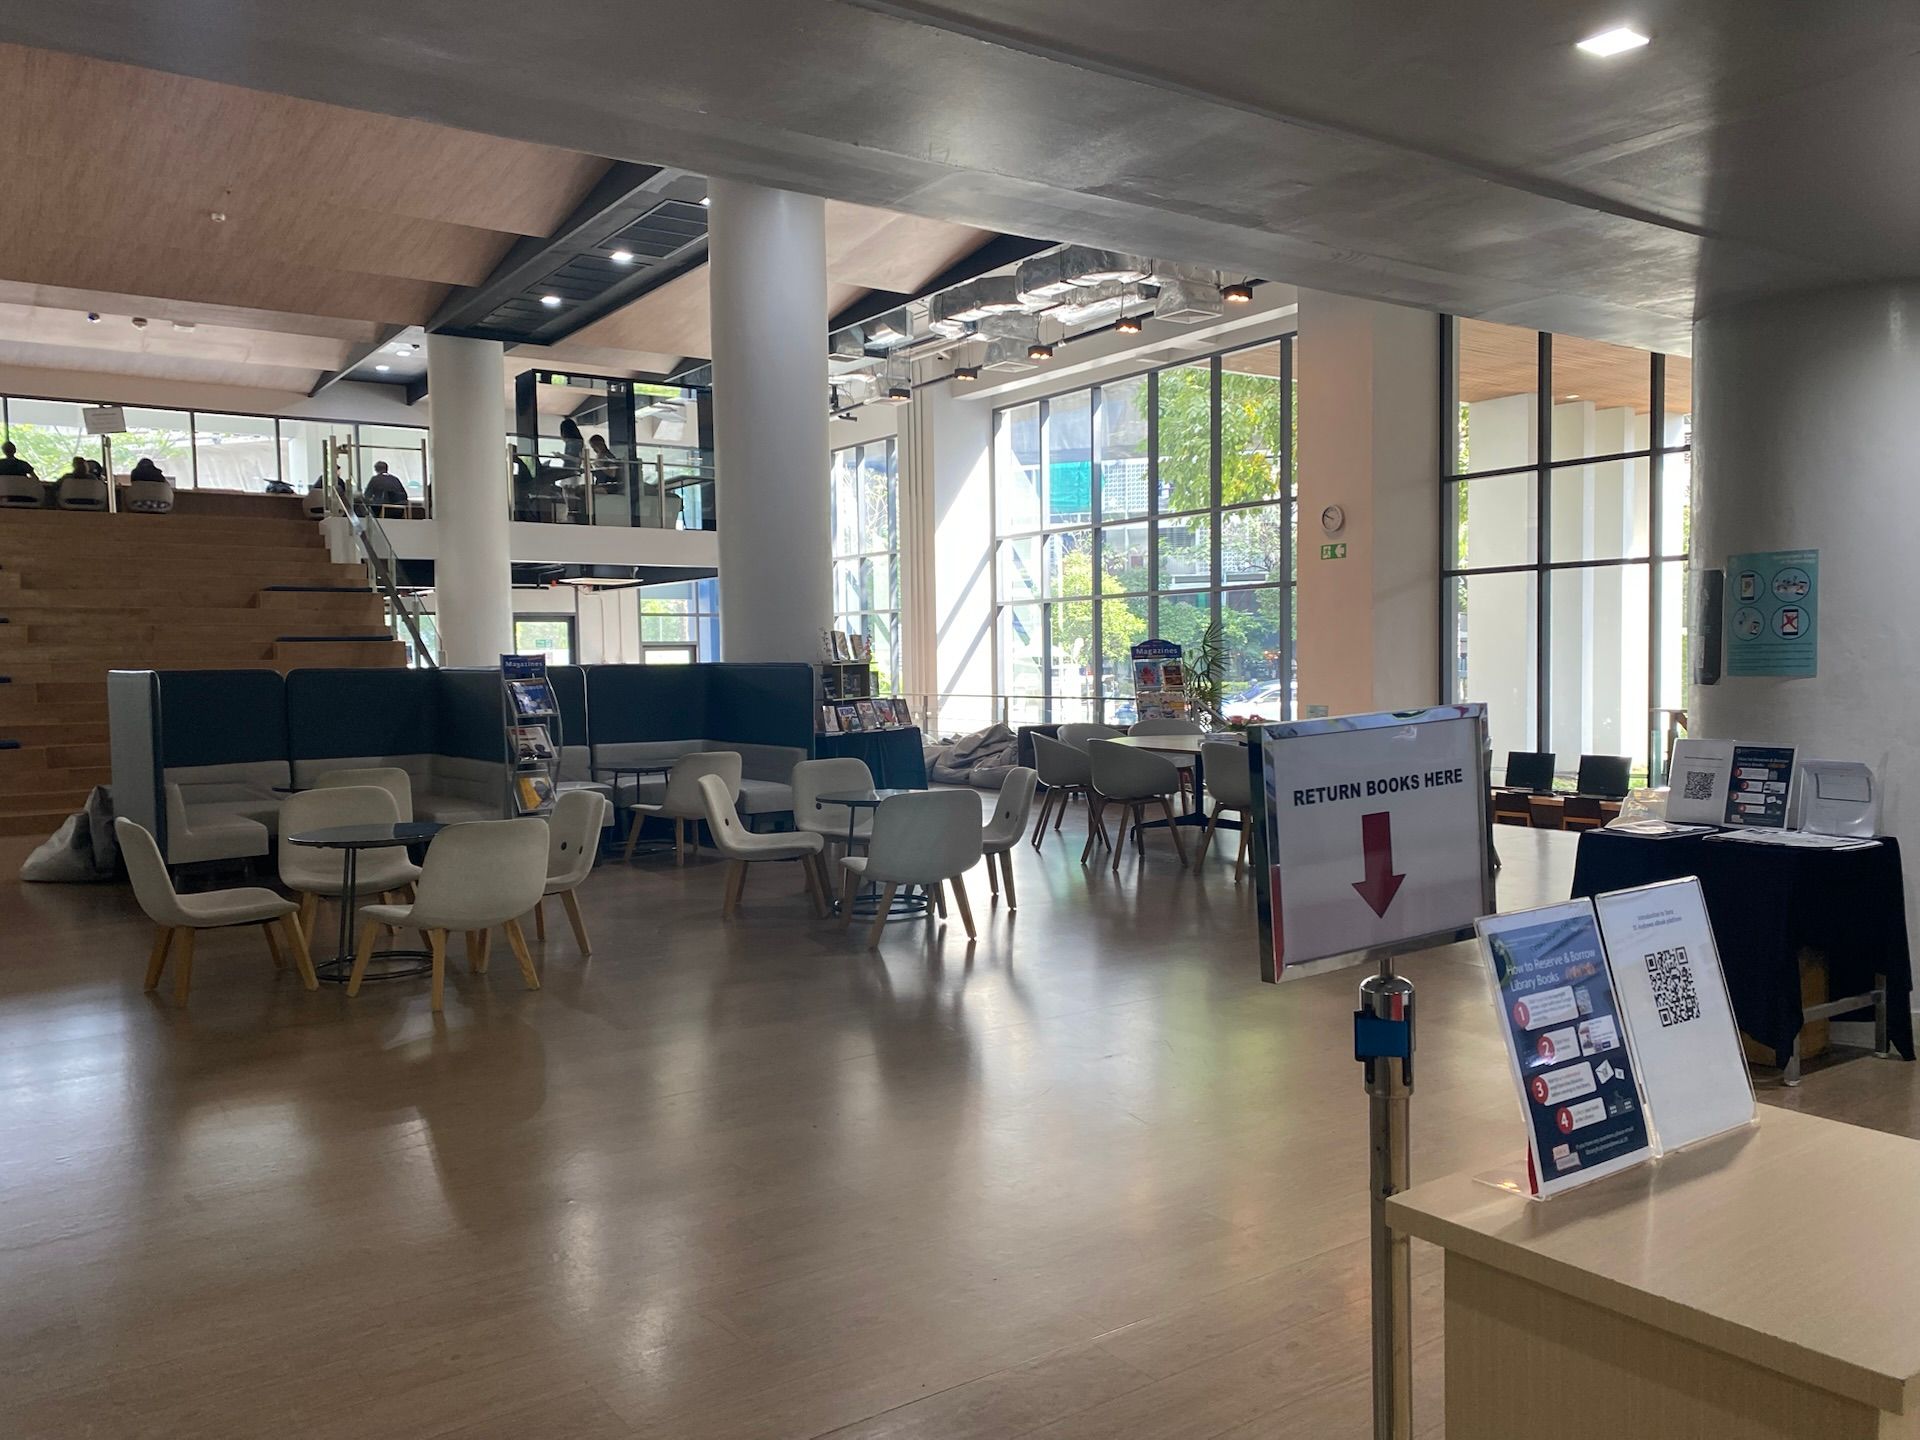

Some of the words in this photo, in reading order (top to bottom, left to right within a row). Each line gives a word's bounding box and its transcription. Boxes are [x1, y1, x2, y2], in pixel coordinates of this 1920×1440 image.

[1136, 648, 1178, 656] Magazines
[1293, 782, 1361, 806] RETURN
[1367, 774, 1420, 796] BOOKS
[1425, 768, 1463, 788] HERE
[1506, 964, 1524, 976] How
[1524, 961, 1534, 972] to
[1534, 956, 1563, 969] Reserve
[1570, 949, 1596, 961] Borrow
[1510, 977, 1536, 992] Library
[1536, 972, 1560, 986] Books
[1518, 1006, 1526, 1020] 1
[1542, 1041, 1552, 1056] 2
[1535, 1081, 1544, 1097] 3
[1560, 1112, 1569, 1128] 4
